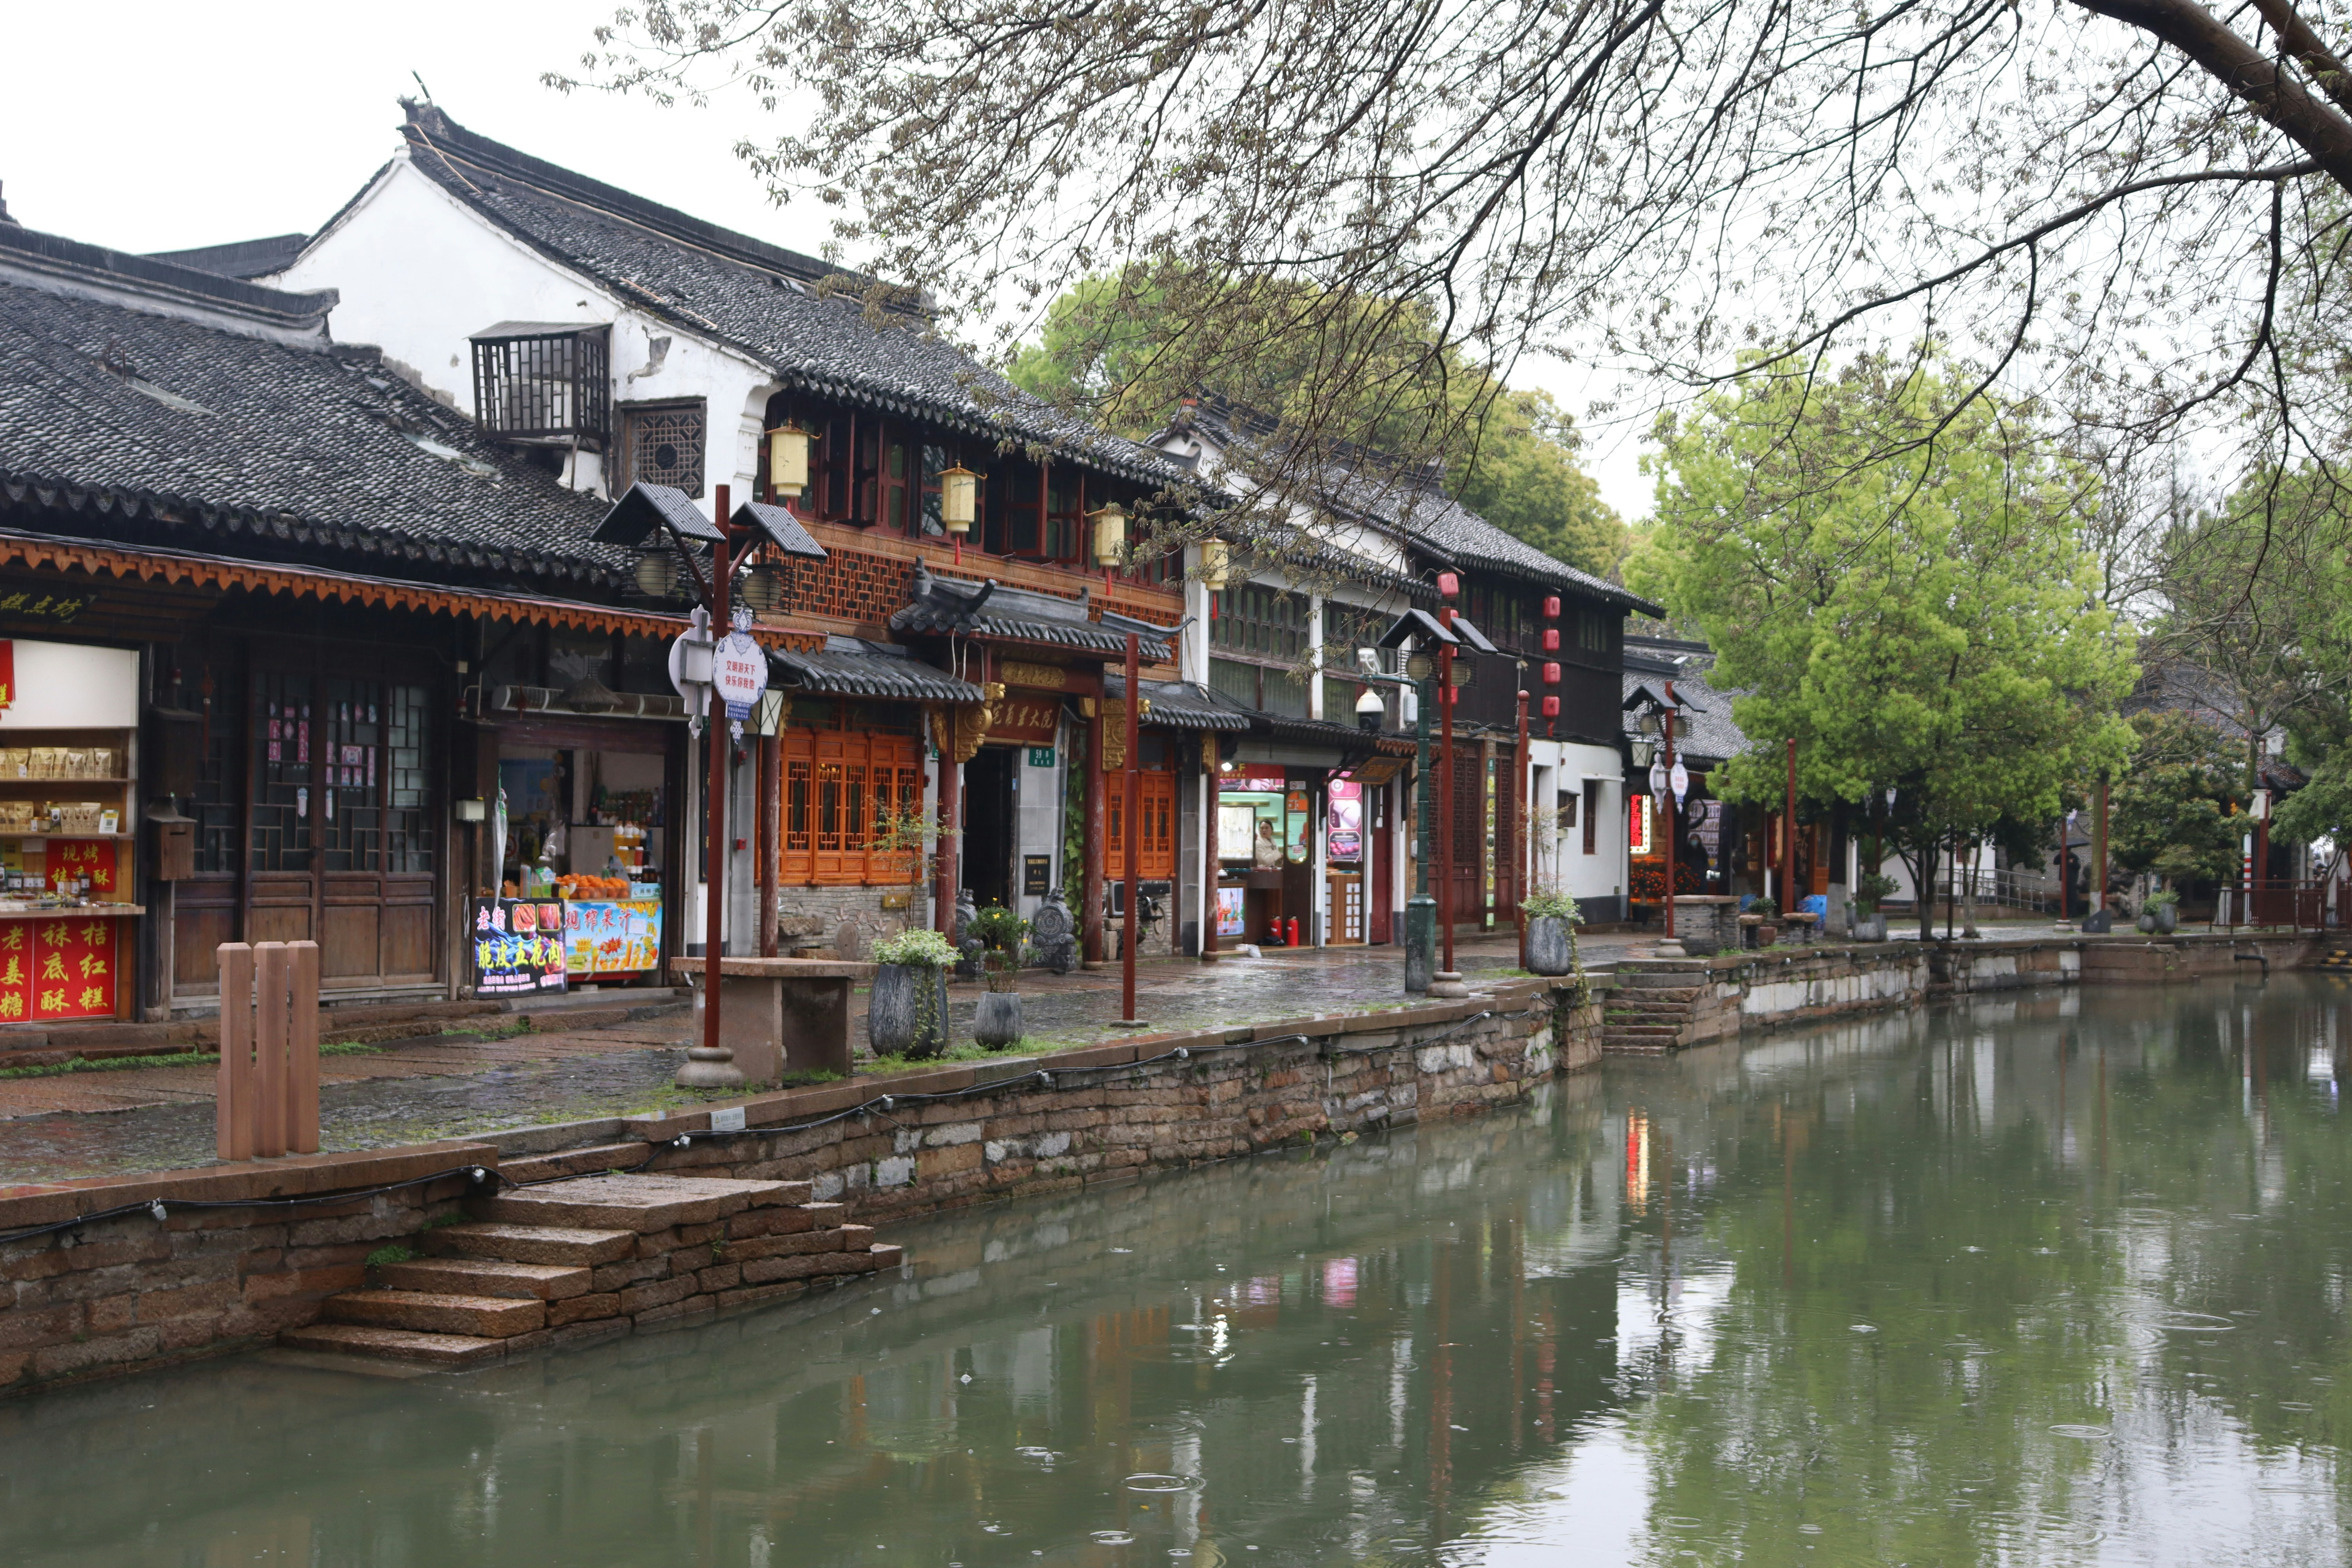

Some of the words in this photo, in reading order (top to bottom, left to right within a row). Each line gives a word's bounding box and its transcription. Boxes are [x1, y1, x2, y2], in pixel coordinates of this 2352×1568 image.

[726, 660, 756, 675] 文明游天下
[726, 674, 755, 690] 快乐你我他
[1036, 749, 1042, 759] 59
[62, 843, 99, 864] 现烤
[477, 906, 506, 931] 老街
[564, 907, 632, 933] 现榨果汁
[478, 935, 561, 970] 脆皮五花肉
[0, 924, 25, 1018] 老姜糖
[41, 921, 72, 1013] 袜底酥
[78, 920, 108, 1011] 桔红糕
